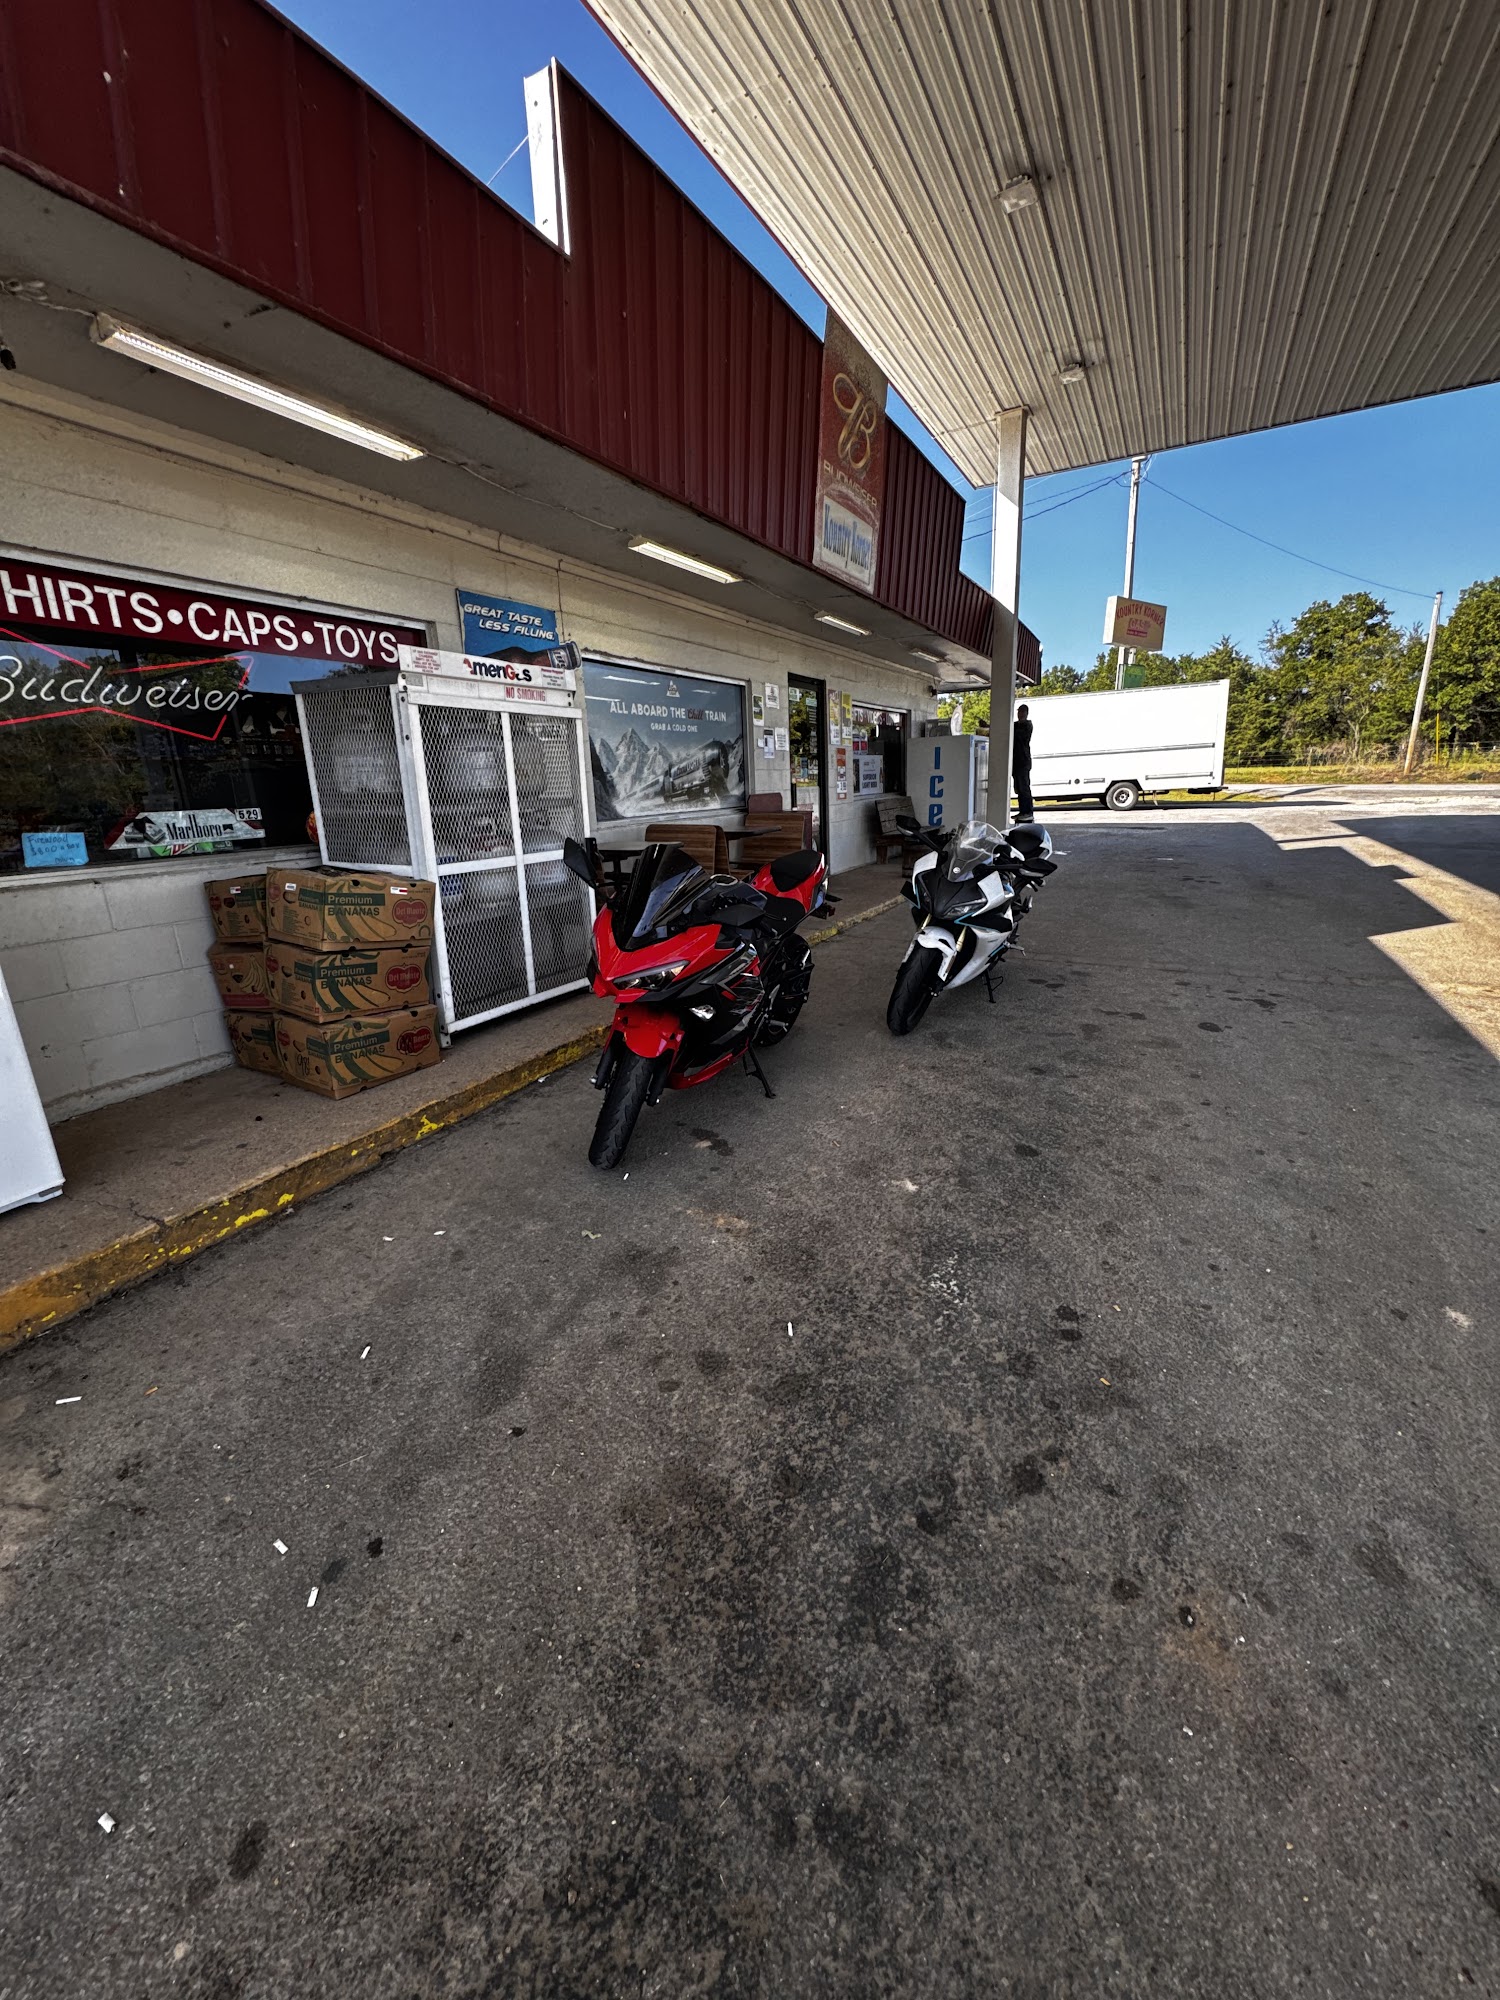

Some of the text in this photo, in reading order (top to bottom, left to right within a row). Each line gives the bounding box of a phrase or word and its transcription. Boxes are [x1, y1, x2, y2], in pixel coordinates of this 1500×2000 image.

[0, 569, 164, 634] HIRTS
[187, 601, 299, 652] CAPS
[313, 620, 399, 664] TOYS
[464, 603, 543, 627] GREAT TASTE.
[1116, 603, 1165, 627] KOUNTRY KORNER
[479, 618, 555, 641] LESS FILLING.
[0, 654, 253, 712] Budweiser
[505, 686, 546, 702] NO SMOKING
[610, 700, 629, 714] ALL
[630, 703, 668, 718] ABOARD
[670, 706, 686, 719] THE
[705, 710, 727, 722] TRAIN
[650, 722, 698, 733] GRAB A COLD ONE
[166, 814, 223, 841] Marlboro
[327, 894, 373, 905] Premium
[327, 907, 380, 917] BANANAS
[320, 965, 365, 978] Premium
[320, 976, 373, 990] BNANAS
[333, 1035, 378, 1052] Premium
[335, 1044, 385, 1064] BANANAS
